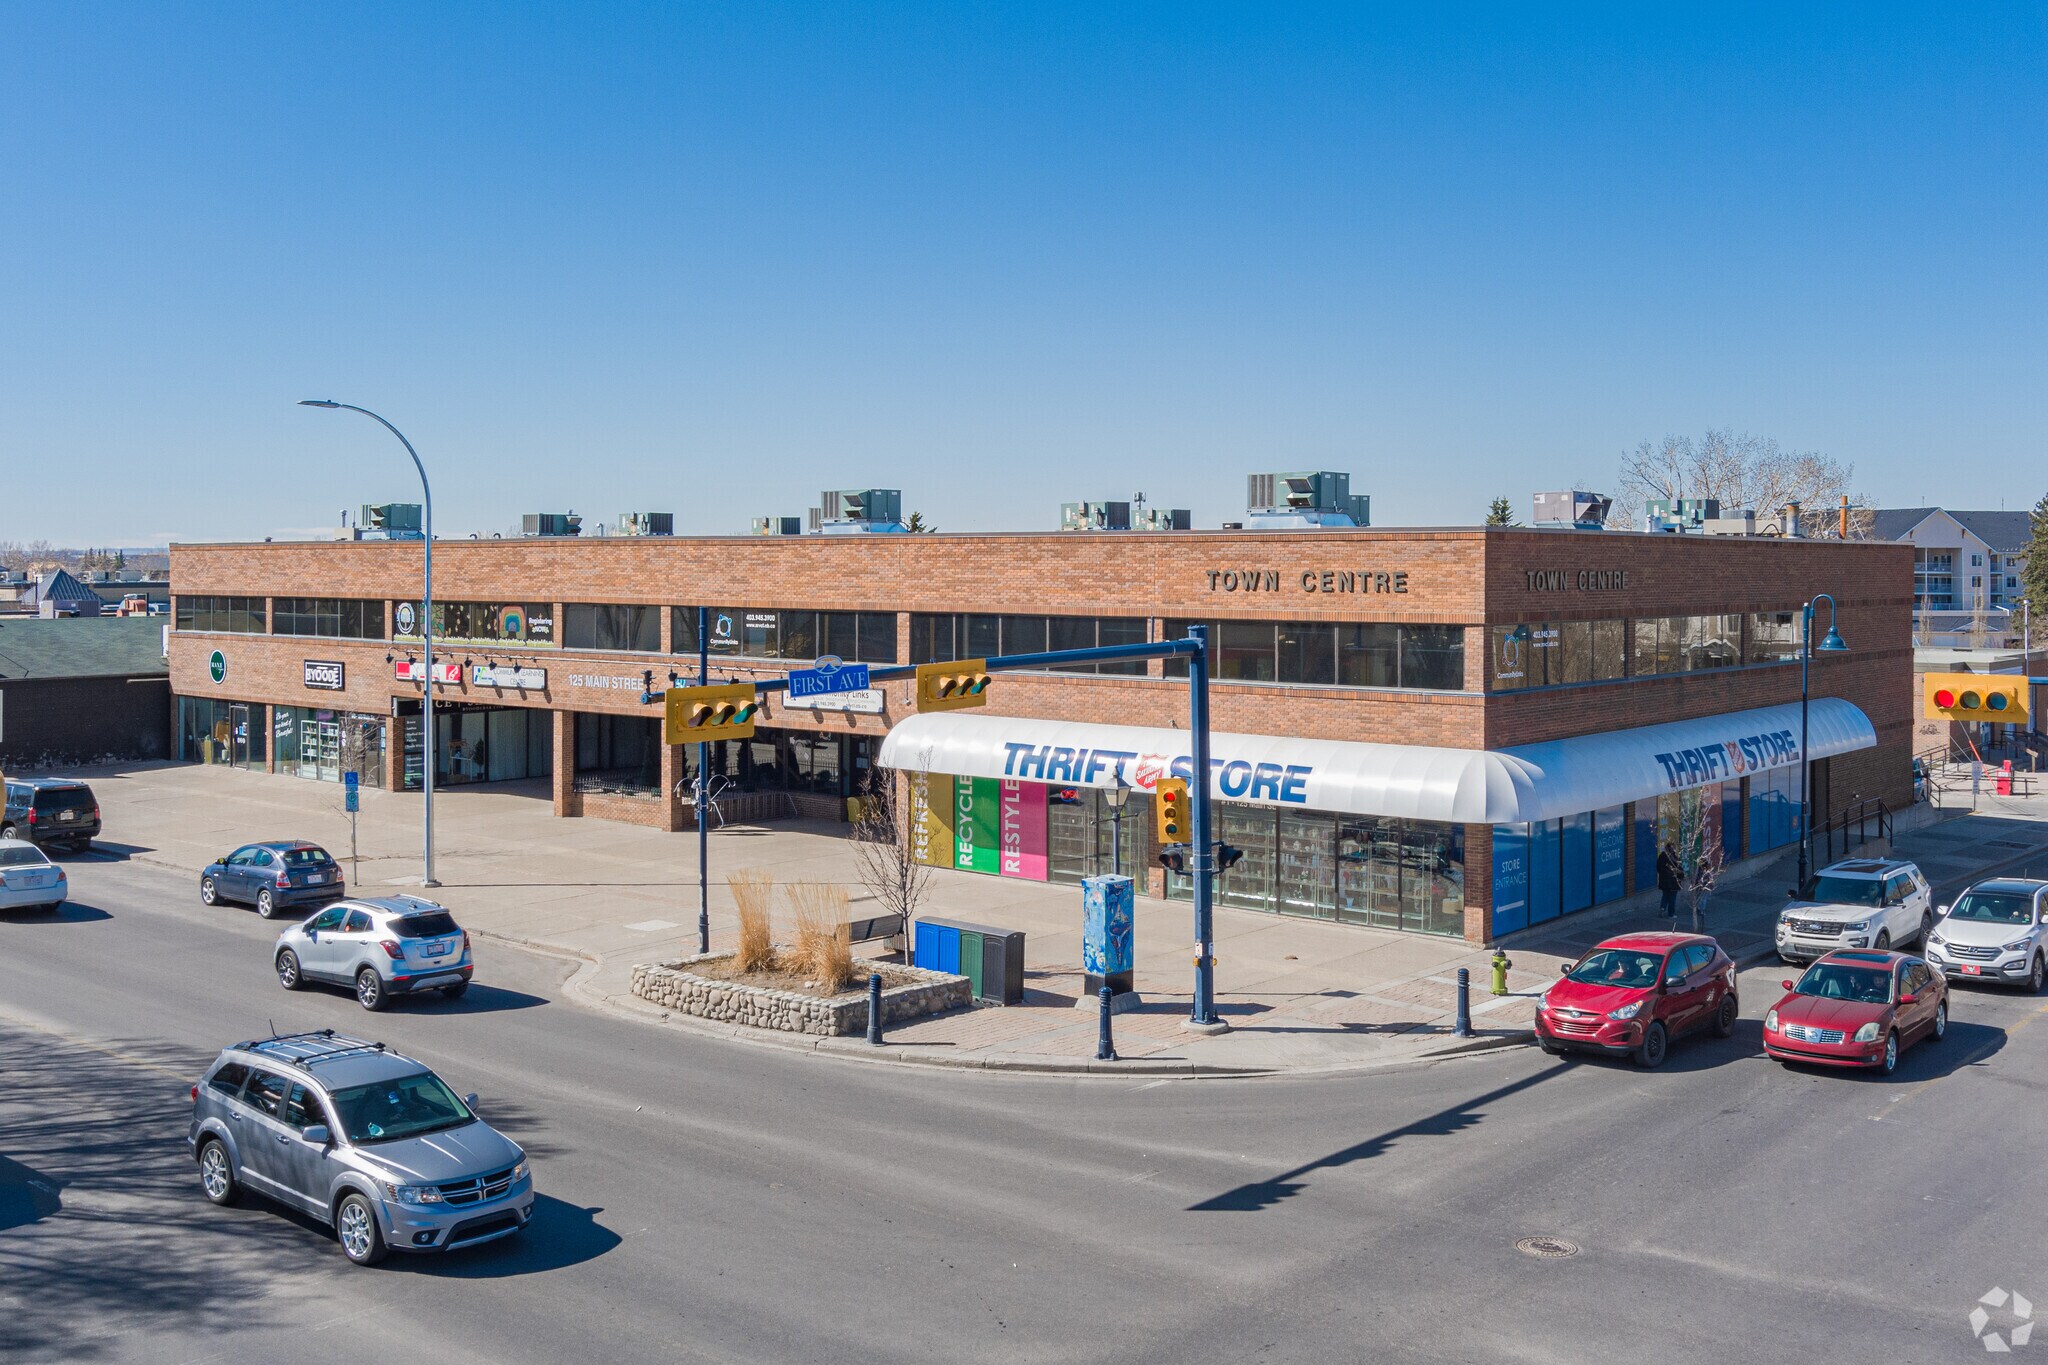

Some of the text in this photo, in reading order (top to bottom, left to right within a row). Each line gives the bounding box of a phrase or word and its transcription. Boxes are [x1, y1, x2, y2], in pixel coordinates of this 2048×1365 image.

[1206, 570, 1408, 593] TOWN CENTRE
[1527, 571, 1628, 591] TOWN CENTRE
[569, 675, 644, 691] 125 MAIN STREE
[793, 672, 867, 693] FIRST AVE
[418, 700, 452, 709] FCE
[852, 691, 869, 699] Links
[1003, 742, 1138, 783] THRIFT
[1655, 744, 1729, 787] THRIFT
[1739, 730, 1799, 771] STORE
[914, 770, 928, 860] REFRESH
[959, 775, 973, 866] RECYCLE
[1005, 779, 1020, 873] RESTYLE
[1502, 859, 1520, 873] STORE
[1601, 849, 1620, 863] CENTRE
[1495, 872, 1527, 890] ENTRANCE
